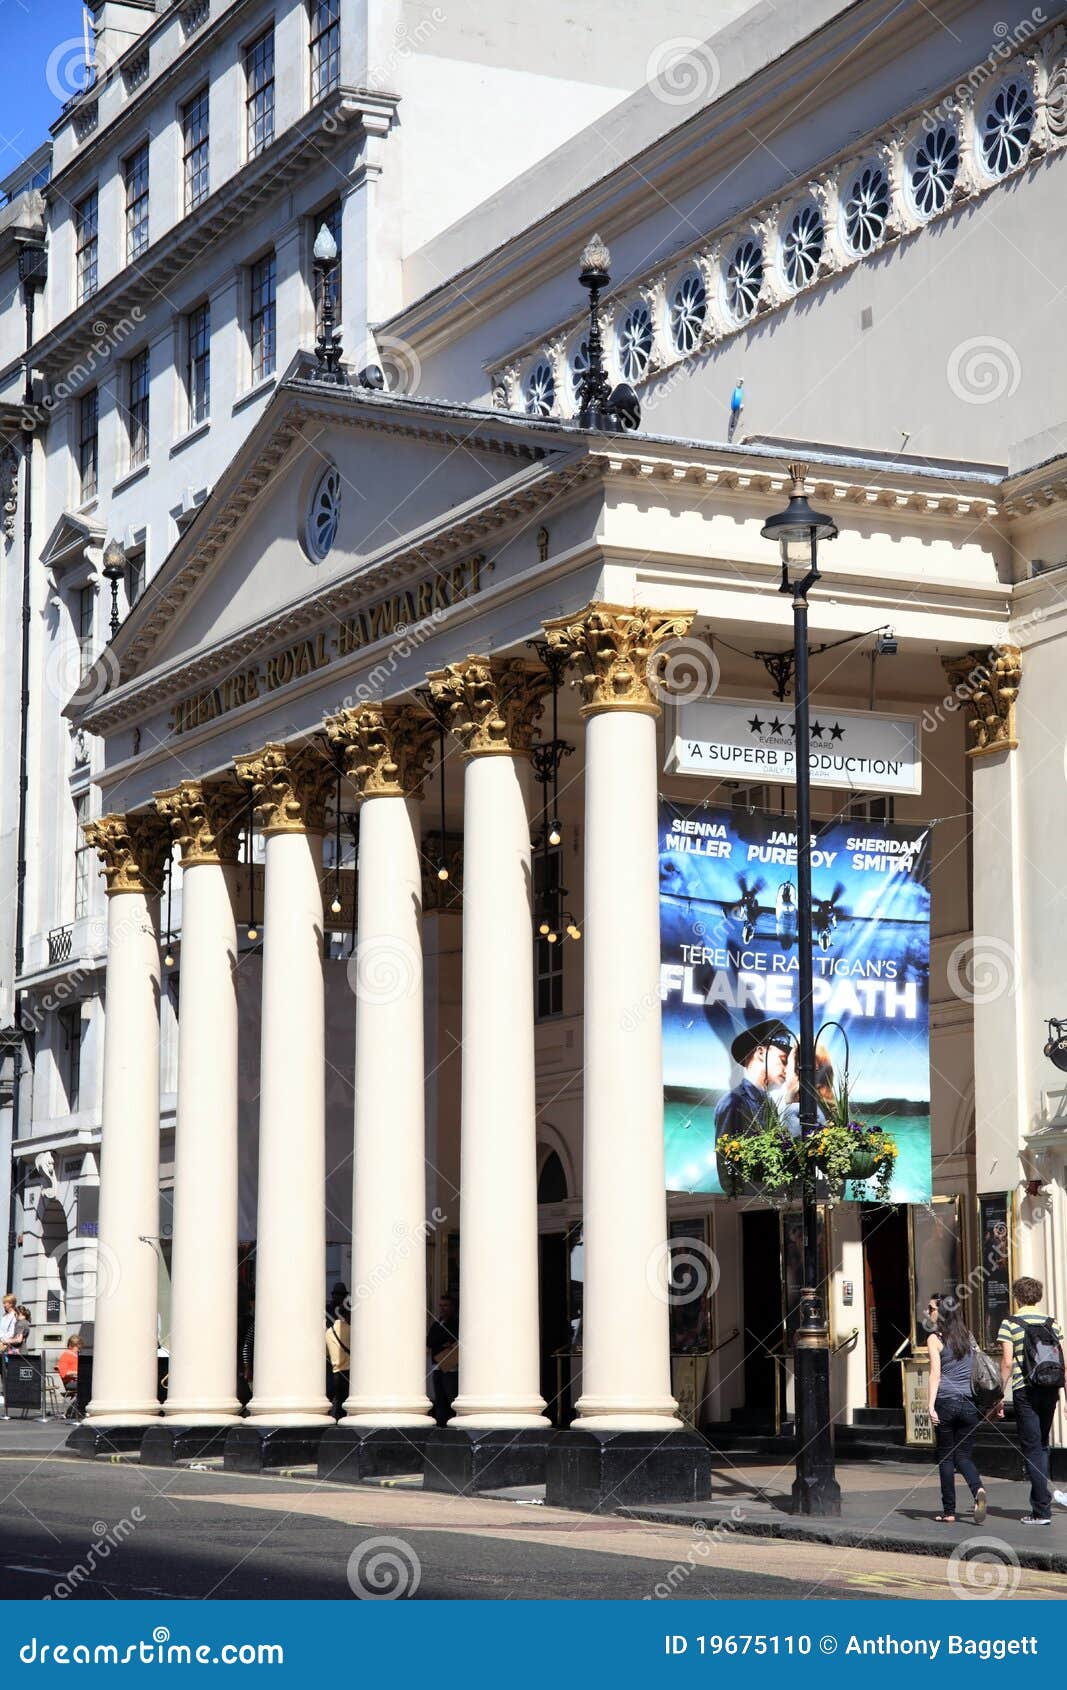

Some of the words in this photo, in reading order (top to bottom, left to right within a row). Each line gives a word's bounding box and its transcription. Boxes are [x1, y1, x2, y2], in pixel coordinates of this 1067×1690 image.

[170, 665, 260, 735] THEATRE
[265, 632, 330, 690] ROYAL
[336, 553, 486, 657] HAYMARKET
[759, 736, 793, 746] EVENING
[709, 745, 778, 765] SUPERB
[784, 752, 903, 776] PODUCTION’
[672, 819, 727, 838] SIENNA
[666, 834, 731, 859] MILLER
[767, 831, 817, 848] JAMS
[846, 838, 922, 854] SHERIDAN
[747, 845, 838, 868] PUREOY
[852, 854, 913, 872] SMITH
[680, 944, 766, 971] TERENCE
[773, 954, 897, 978] RATIGAN’S
[660, 963, 794, 1012] FLARE
[914, 1415, 930, 1427] NOW
[914, 1428, 931, 1440] OPEN
